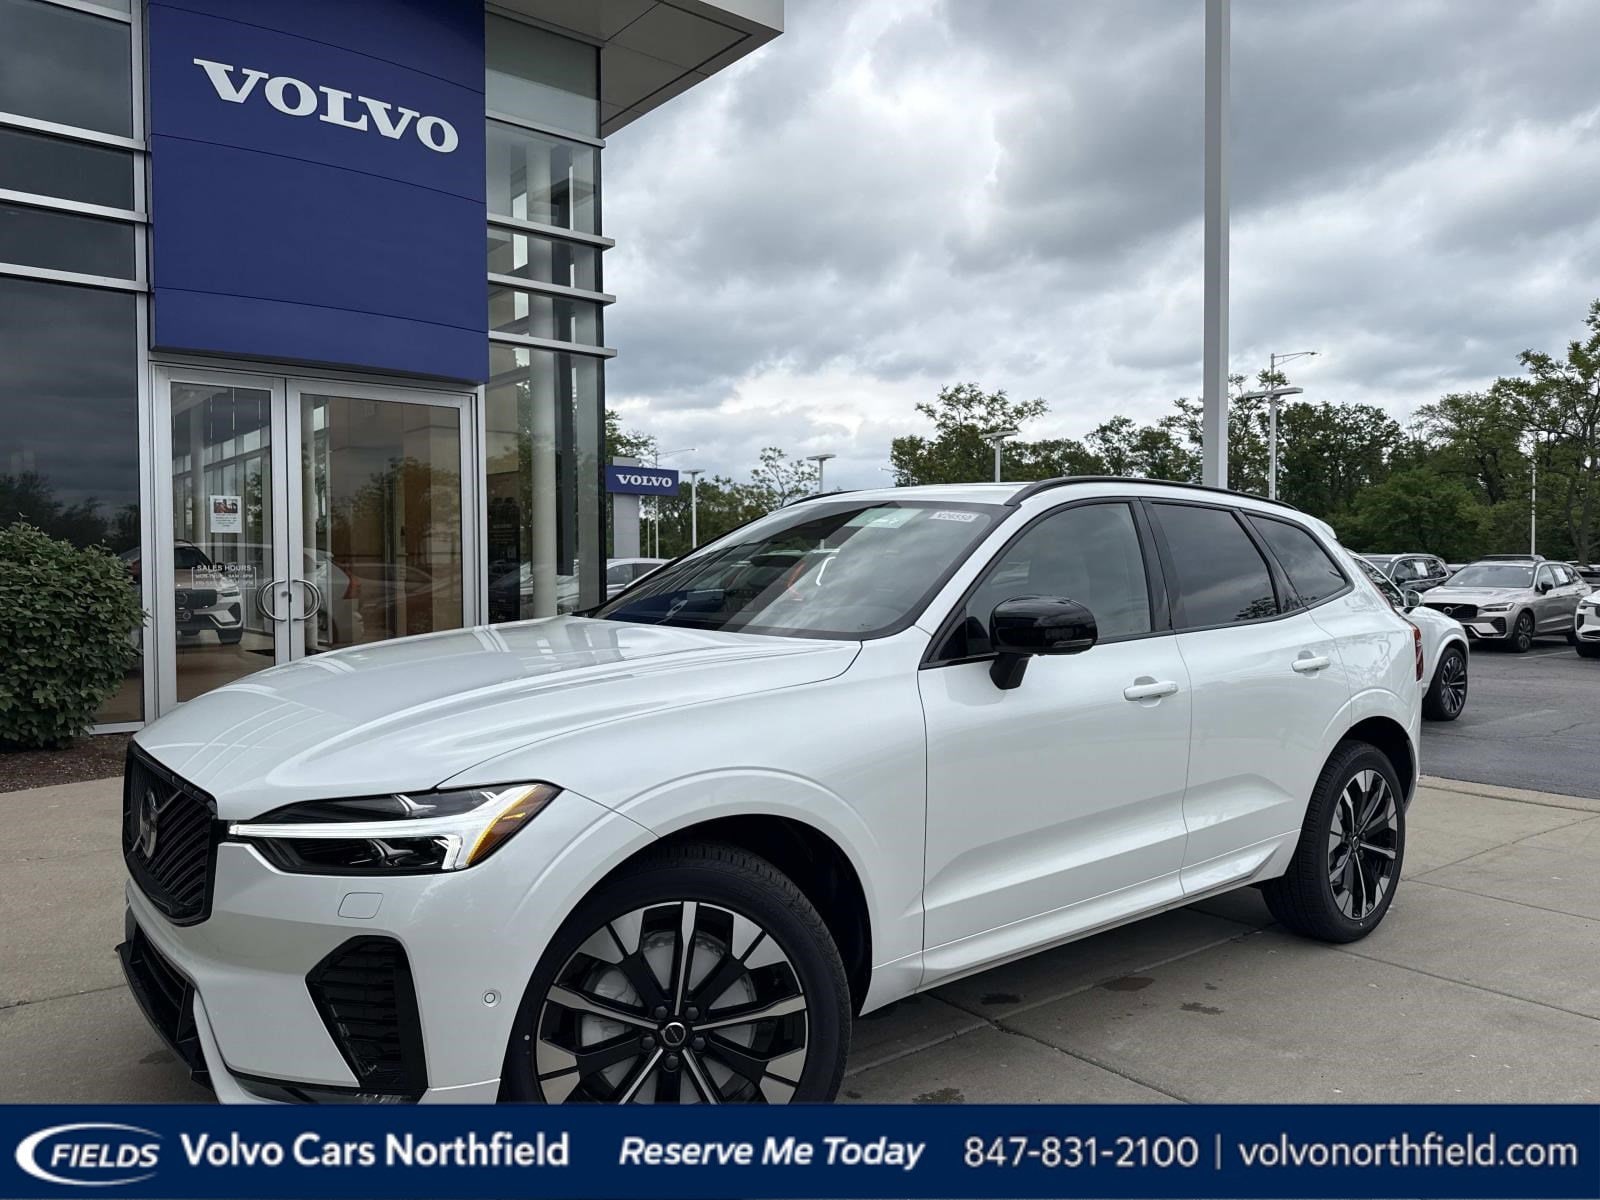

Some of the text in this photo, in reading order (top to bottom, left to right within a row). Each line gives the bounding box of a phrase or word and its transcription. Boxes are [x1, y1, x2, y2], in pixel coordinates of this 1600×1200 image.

[193, 58, 459, 153] VOLVO
[616, 474, 673, 488] VOLVO
[196, 564, 223, 572] SALES
